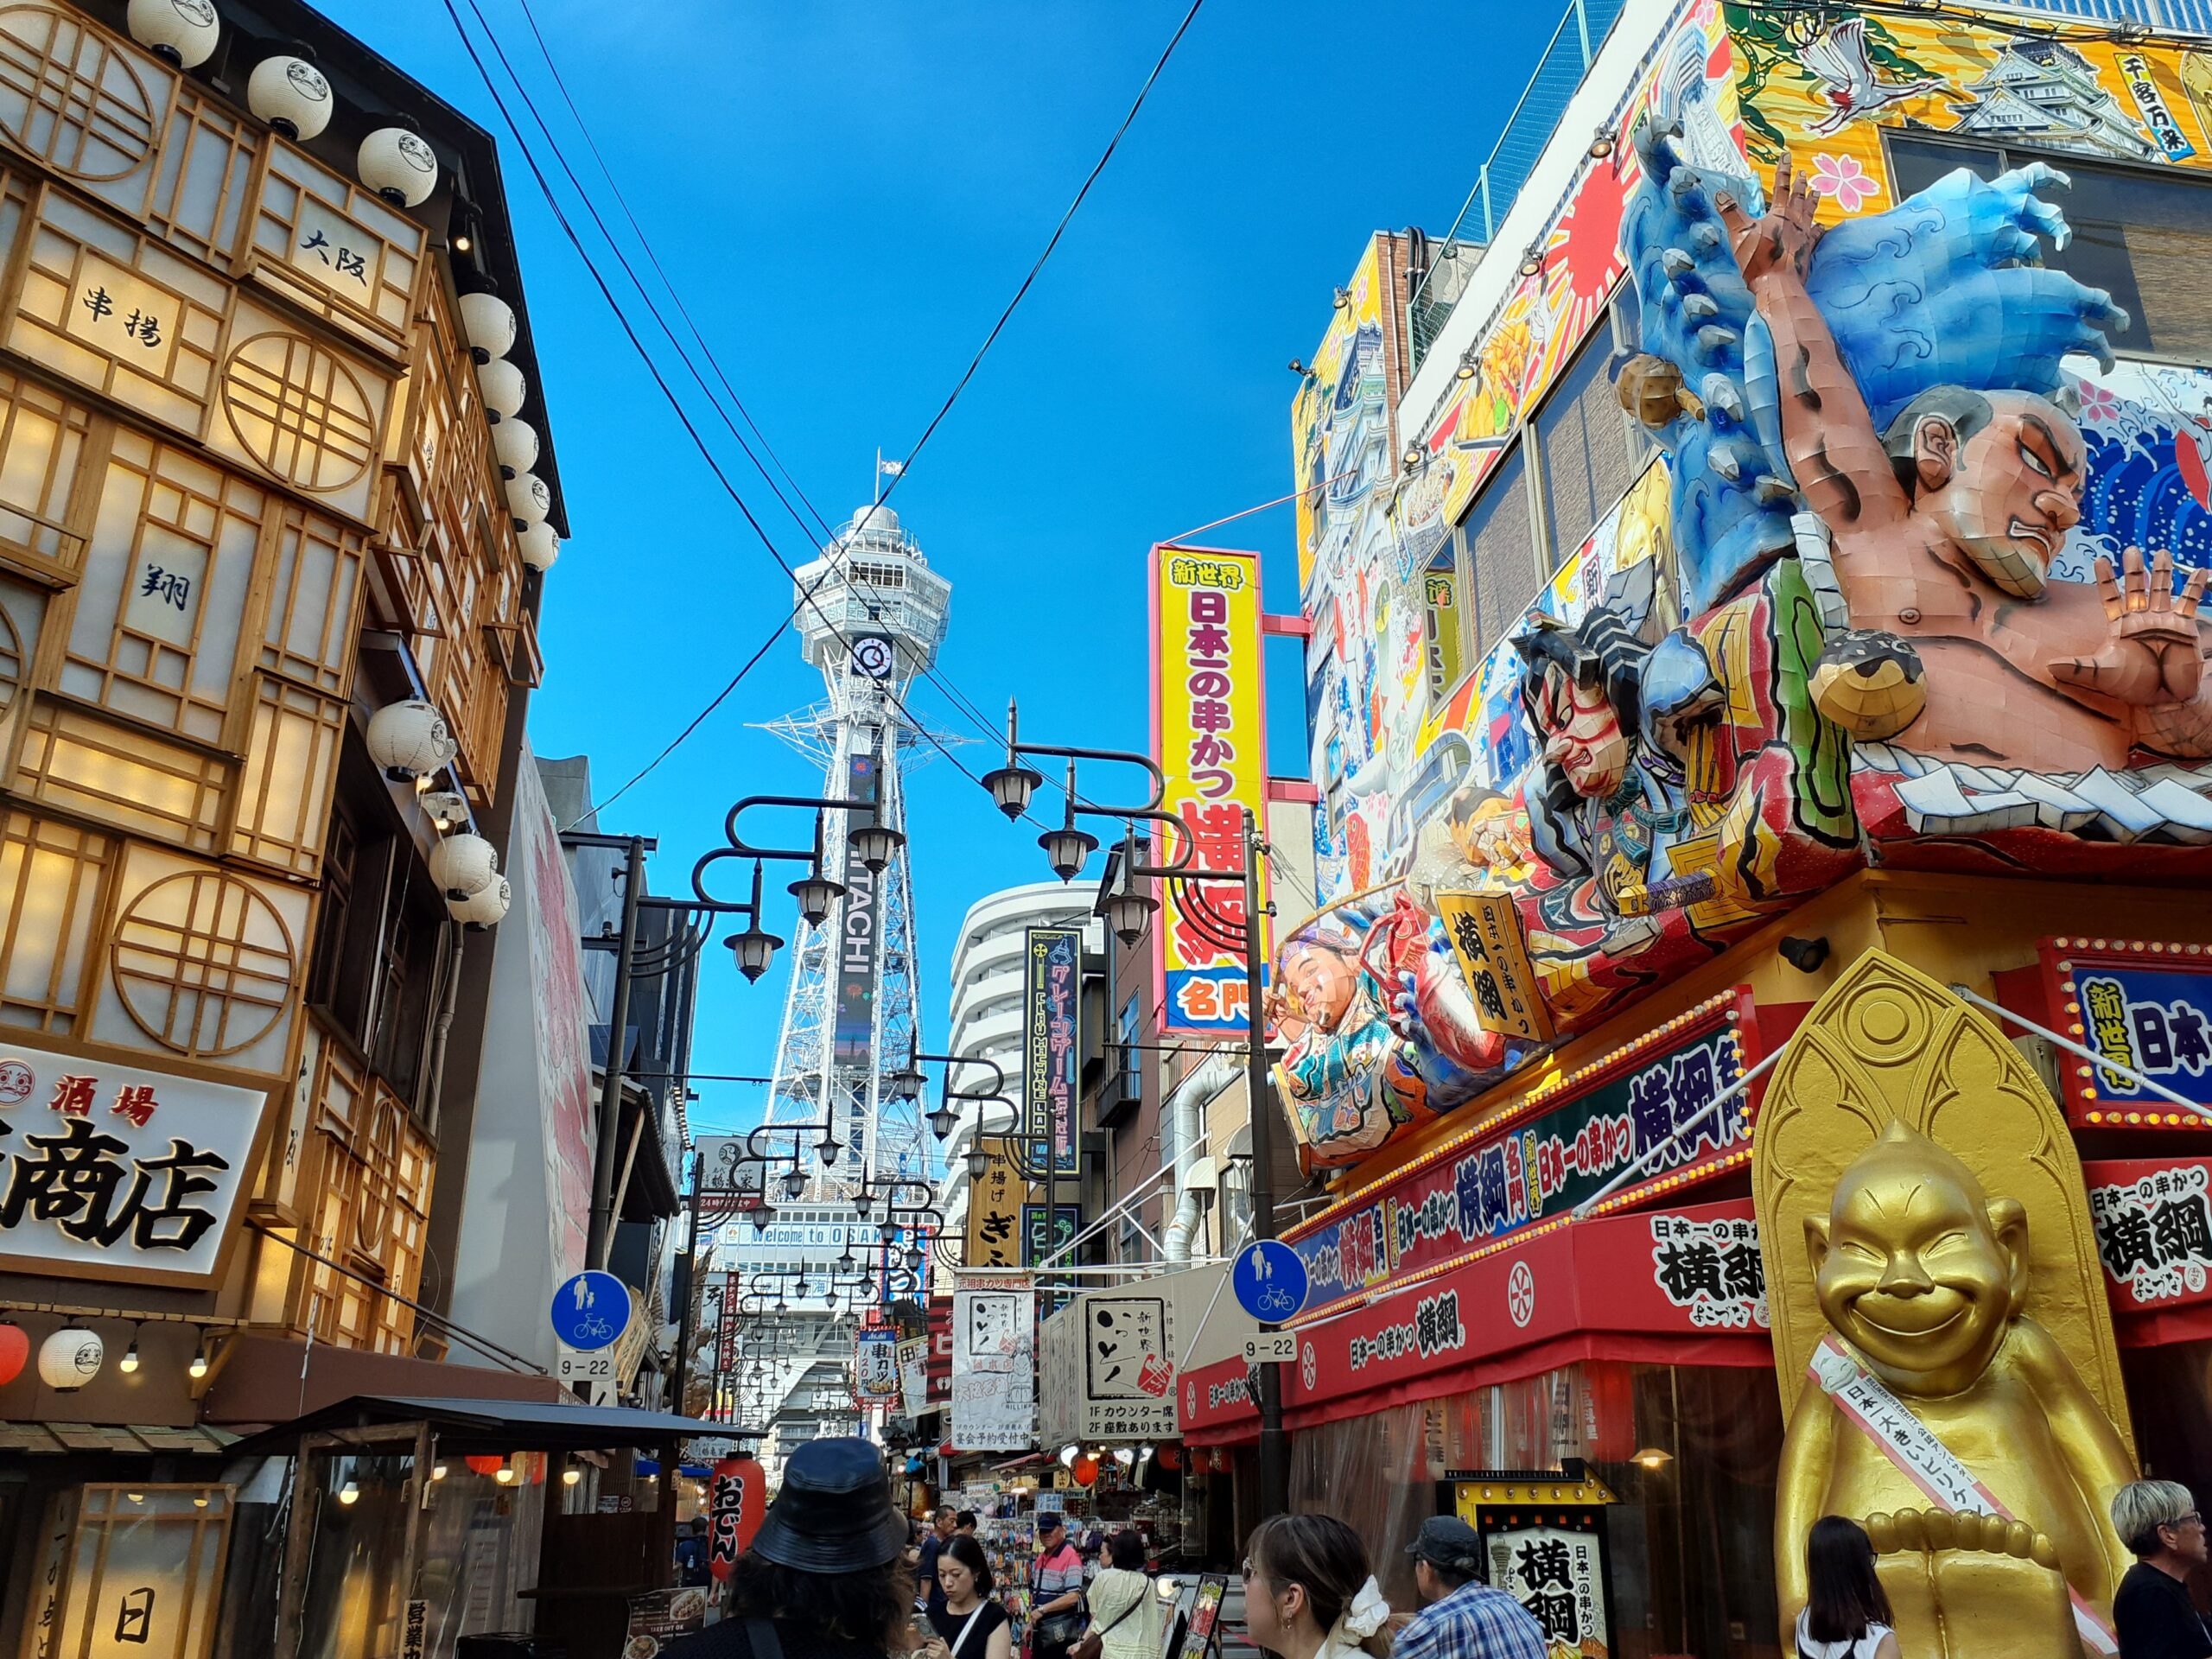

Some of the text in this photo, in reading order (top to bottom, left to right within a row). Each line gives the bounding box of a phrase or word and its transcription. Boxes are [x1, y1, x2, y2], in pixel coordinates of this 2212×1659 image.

[2123, 58, 2185, 150] 千客万来
[301, 230, 367, 288] 大阪
[82, 285, 162, 347] 串揚
[142, 563, 190, 611] 翔
[1172, 561, 1243, 588] 新世界
[1188, 591, 1234, 799] 日本一の串かつ
[843, 850, 874, 973] ITACHI
[1452, 911, 1508, 1020] 横綱
[1483, 906, 1529, 1034] 日本一の串かつ
[2089, 985, 2212, 1088] 新世界 日本
[48, 1074, 159, 1127] 酒場
[1398, 1192, 1455, 1250] 日本一の串かつ
[1457, 1147, 1509, 1241] 横綱
[1505, 1141, 1526, 1217] 名門
[1524, 1134, 1541, 1213] 新世界
[1539, 1117, 1630, 1192] 日本一の串かつ
[1631, 1046, 1719, 1172] 横綱
[0, 1116, 230, 1252] 商店
[990, 1154, 1007, 1202] 串揚げ
[2093, 1171, 2205, 1210] 日本一の串かつ
[753, 1228, 802, 1243] Welcome
[809, 1229, 823, 1243] to
[2099, 1201, 2212, 1275] 横綱
[957, 1278, 1031, 1289] 元祖串カツ専門店
[1658, 1241, 1765, 1300] 横綱
[2135, 1272, 2179, 1297] よこづな
[1351, 1294, 1458, 1365] 日本一の串かつ 横綱
[1694, 1305, 1746, 1324] よこづな
[1089, 1406, 1173, 1418] 1F カウンター席
[1210, 1379, 1247, 1408] 日本一の串かつ
[1866, 1377, 1919, 1426] BILLIKEN DIVERSITY
[956, 1432, 1029, 1445] 宴会予約受付中
[1089, 1421, 1174, 1433] 2F 座敷あります
[712, 1476, 743, 1564] おでん
[1516, 1539, 1579, 1643] 横綱
[1576, 1546, 1592, 1635] 日本一の串かつ
